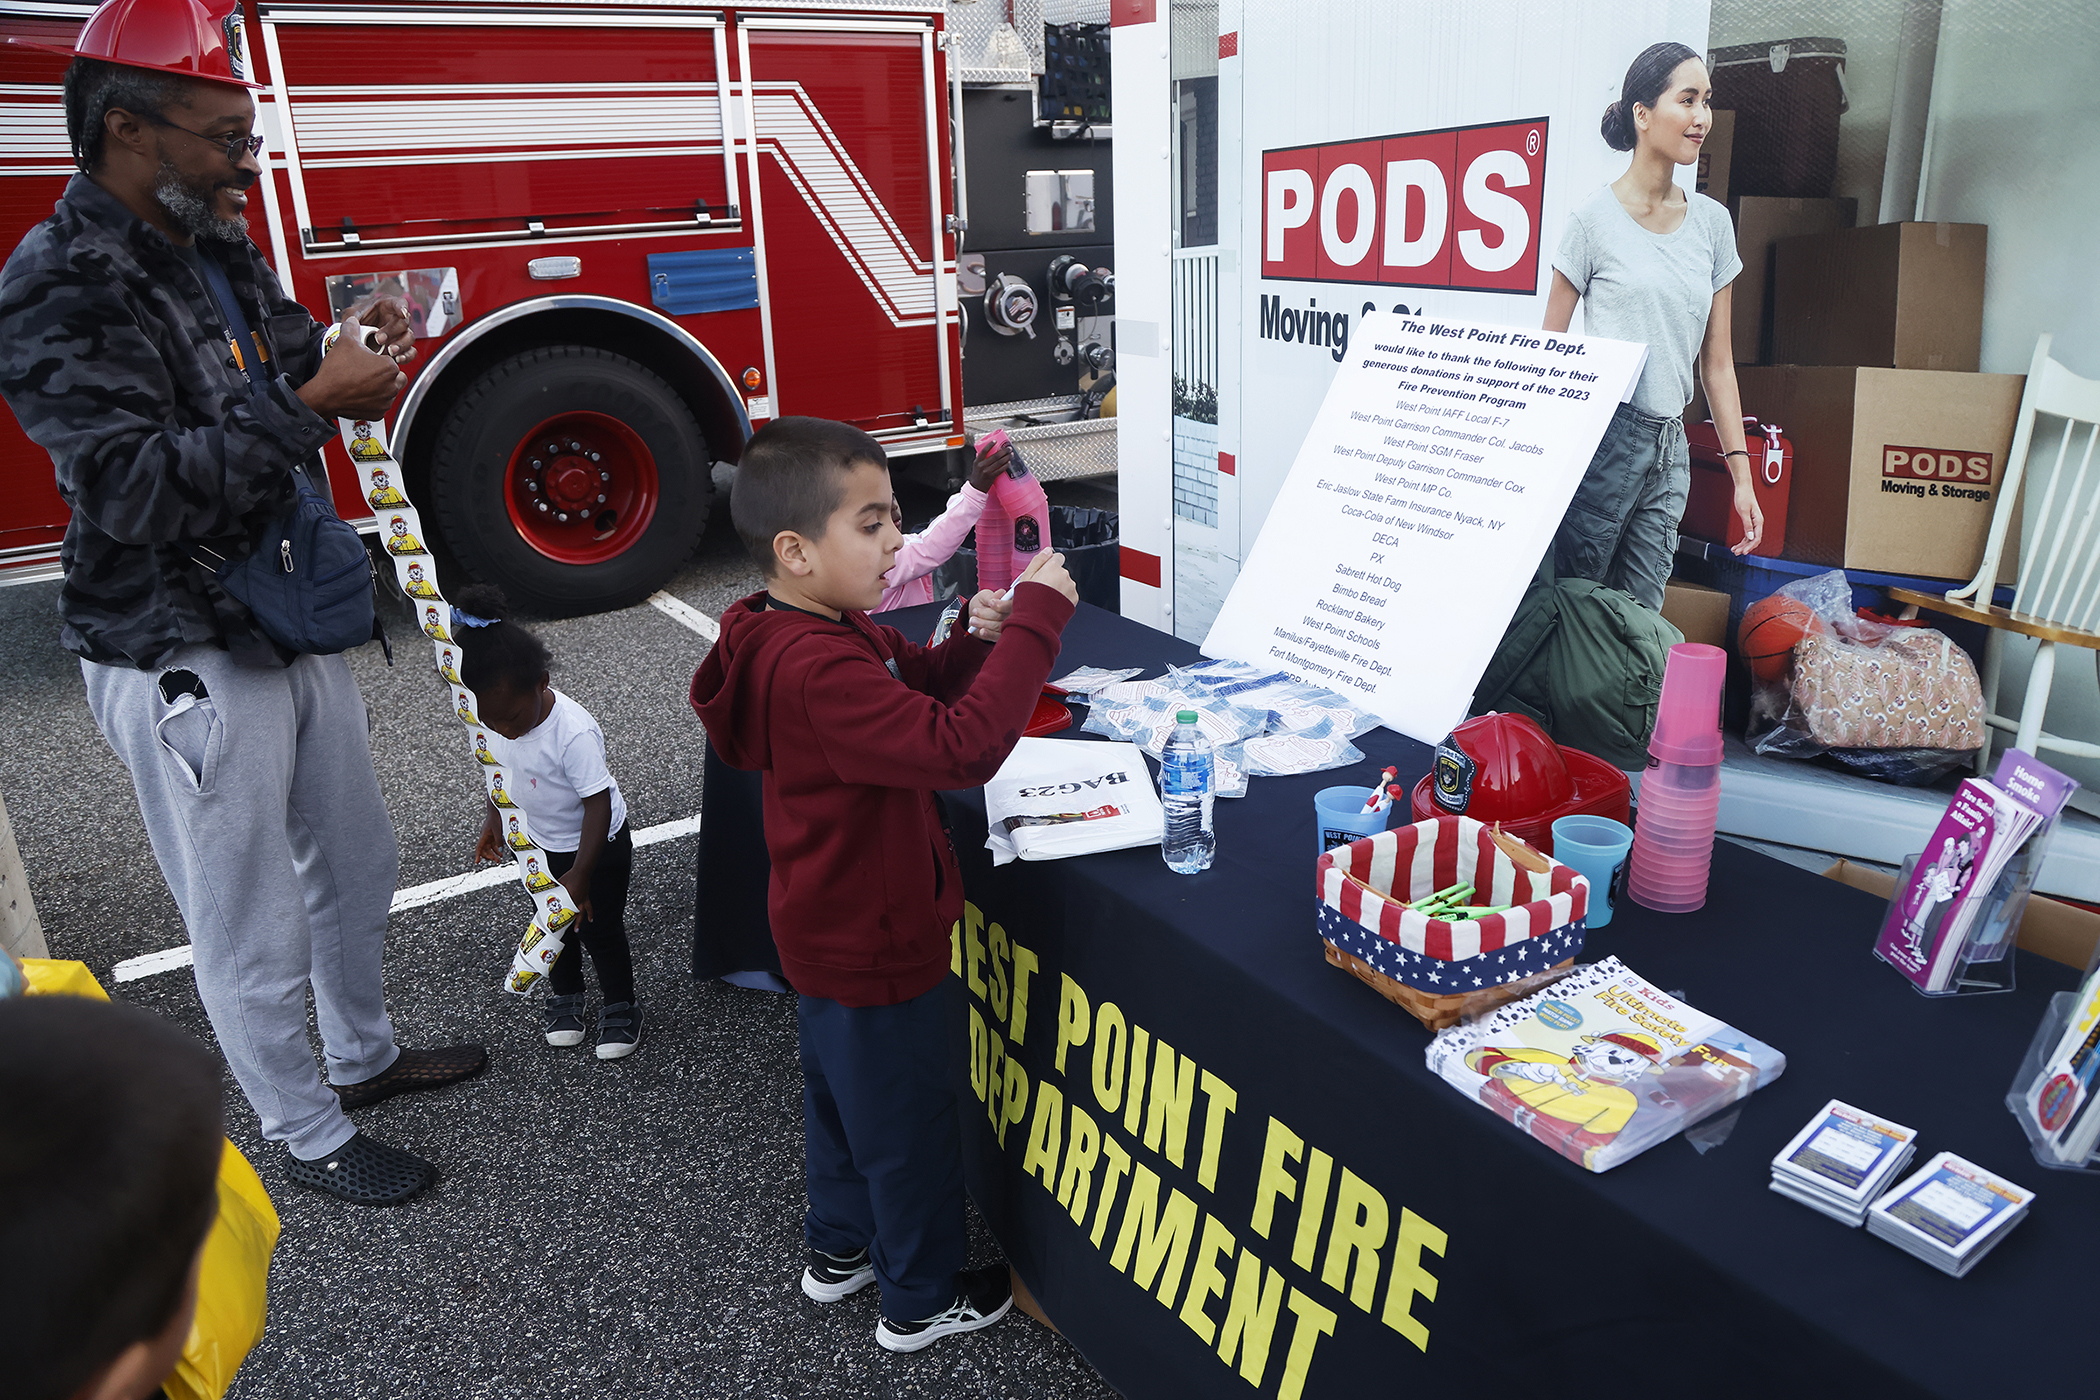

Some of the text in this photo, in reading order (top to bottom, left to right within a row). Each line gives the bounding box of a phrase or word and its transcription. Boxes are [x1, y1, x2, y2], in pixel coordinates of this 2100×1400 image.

[1260, 294, 1349, 363] Moving
[1400, 320, 1586, 356] The West Point Fire Dept.
[1374, 343, 1599, 382] would like to thank the following for their
[1362, 359, 1590, 402] generous donations in support of the 2023
[1398, 380, 1527, 410] Fire Prevention Program
[1396, 400, 1510, 428] West Point IAFF Local F-7
[1350, 410, 1545, 456] West Point Garrison Commander Col. Jacobs
[1383, 436, 1485, 464] West Point SGM Fraser
[1885, 450, 1988, 480] PODS
[1333, 444, 1526, 494] West Point Deputy Garrison Commander Cox
[1374, 472, 1453, 498] West Point MP Co.
[1881, 480, 1990, 502] Moving & Storage
[1316, 478, 1506, 532] Eric Jaslow State Farm Insurance Nyack, NY
[1341, 504, 1455, 541] Coca-Cola of New Windsor
[1372, 531, 1400, 548] DECA
[1370, 552, 1386, 565] PX
[1335, 562, 1402, 594] Sabrett Hot Dog
[1332, 582, 1388, 608] Bimbo Bread
[1316, 598, 1386, 632] Rockland Bakery
[1302, 614, 1382, 651] West Point Schools
[1268, 645, 1286, 660] Fort
[1285, 651, 1336, 680] Montgomery
[1336, 670, 1354, 685] Fire
[1354, 676, 1377, 694] Dept.
[1350, 652, 1370, 669] Fire
[1369, 660, 1393, 678] Dept.
[1018, 770, 1130, 798] BAG23
[2006, 776, 2040, 804] Smoke
[2014, 765, 2045, 790] Home
[1961, 788, 1976, 803] Fire
[1961, 802, 1984, 823] Family
[1325, 831, 1342, 840] WEST
[1608, 984, 1688, 1033] Ultimate
[1638, 986, 1675, 1010] Kids
[1594, 991, 1630, 1016] Fire
[1628, 1012, 1693, 1047] Safety
[1055, 971, 1238, 1194] POINT
[1250, 1114, 1449, 1354] FIRE
[968, 1002, 1338, 1400] DEPARTMENT
